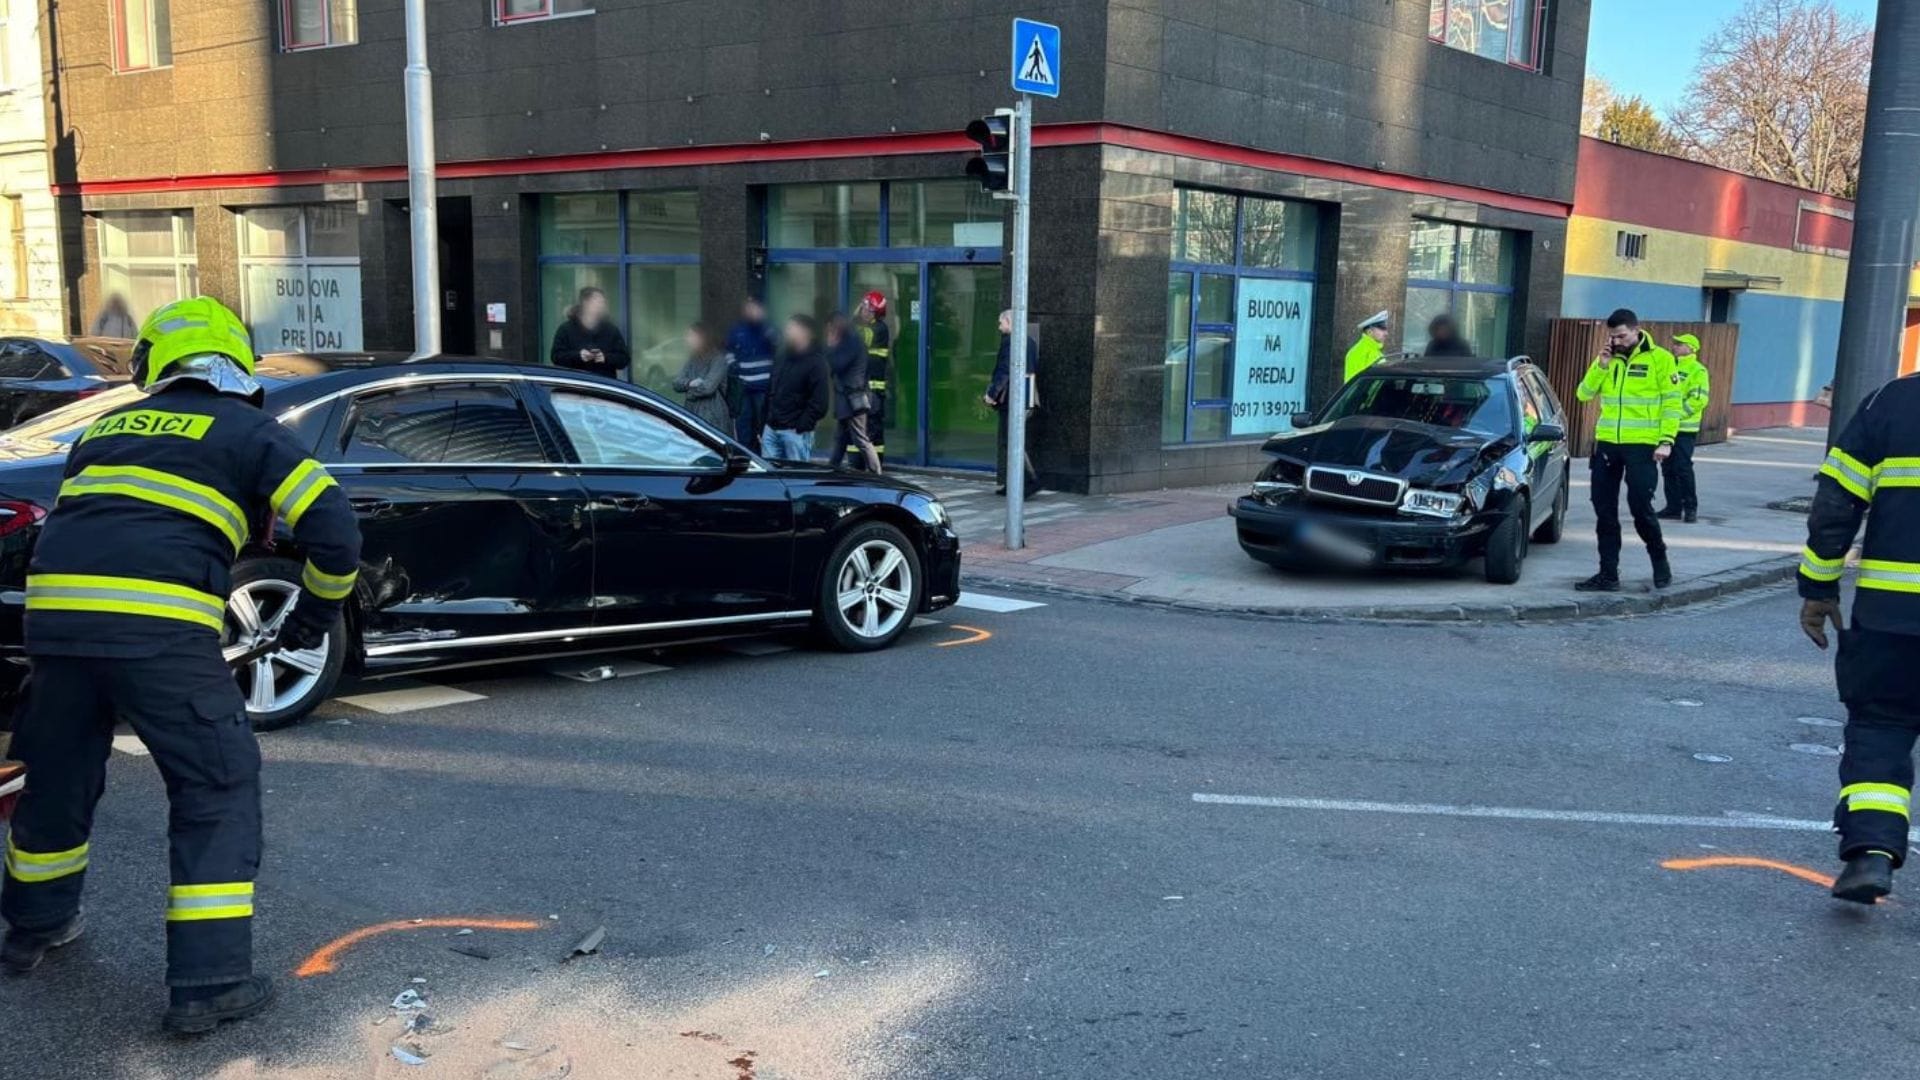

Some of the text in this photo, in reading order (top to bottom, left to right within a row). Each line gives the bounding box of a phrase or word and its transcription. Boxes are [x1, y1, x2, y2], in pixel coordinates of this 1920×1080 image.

[276, 279, 340, 298] BUDOVA
[297, 304, 324, 323] NA
[1248, 300, 1300, 319] BUDOVA
[281, 329, 342, 349] PREDAJ
[1265, 335, 1281, 351] NA
[1248, 367, 1294, 384] PREDAJ
